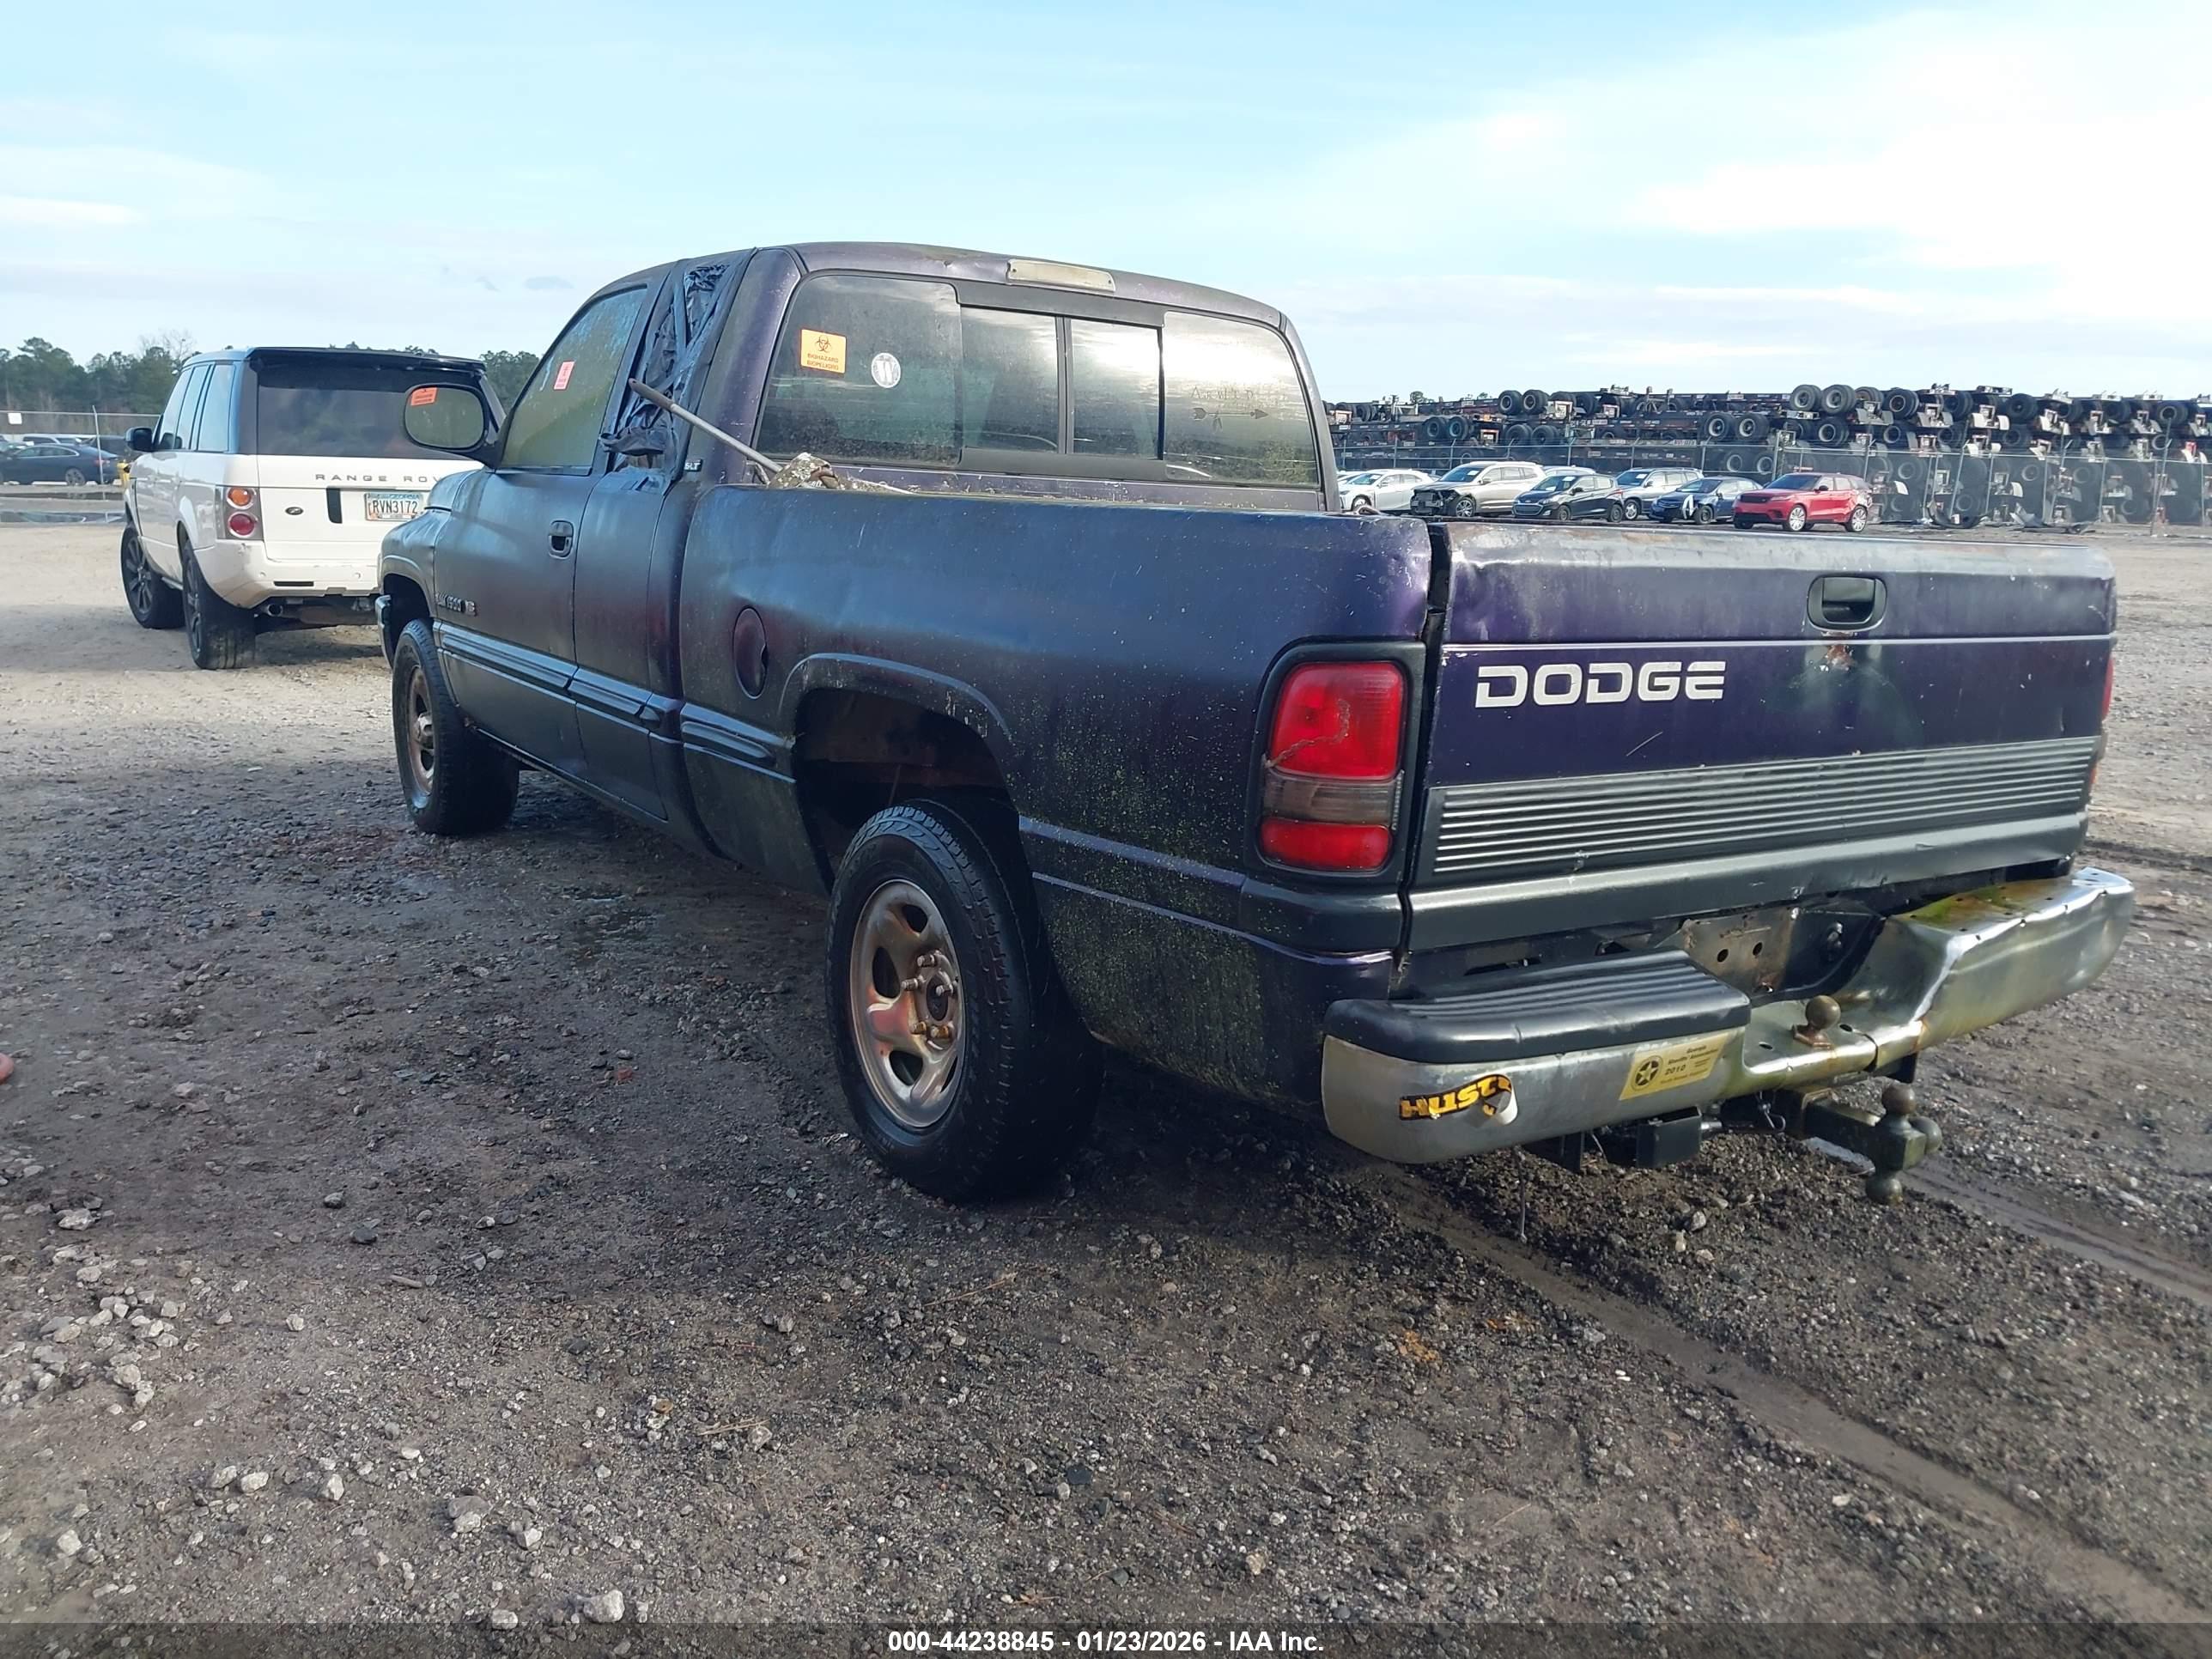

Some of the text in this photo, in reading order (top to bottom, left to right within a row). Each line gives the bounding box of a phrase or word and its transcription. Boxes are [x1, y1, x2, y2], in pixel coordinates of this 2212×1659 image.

[807, 353, 839, 363] BIOHAZARD
[807, 360, 839, 370] BIOPELIGRO
[373, 500, 418, 514] RVN3172
[1475, 661, 1726, 708] DODGE
